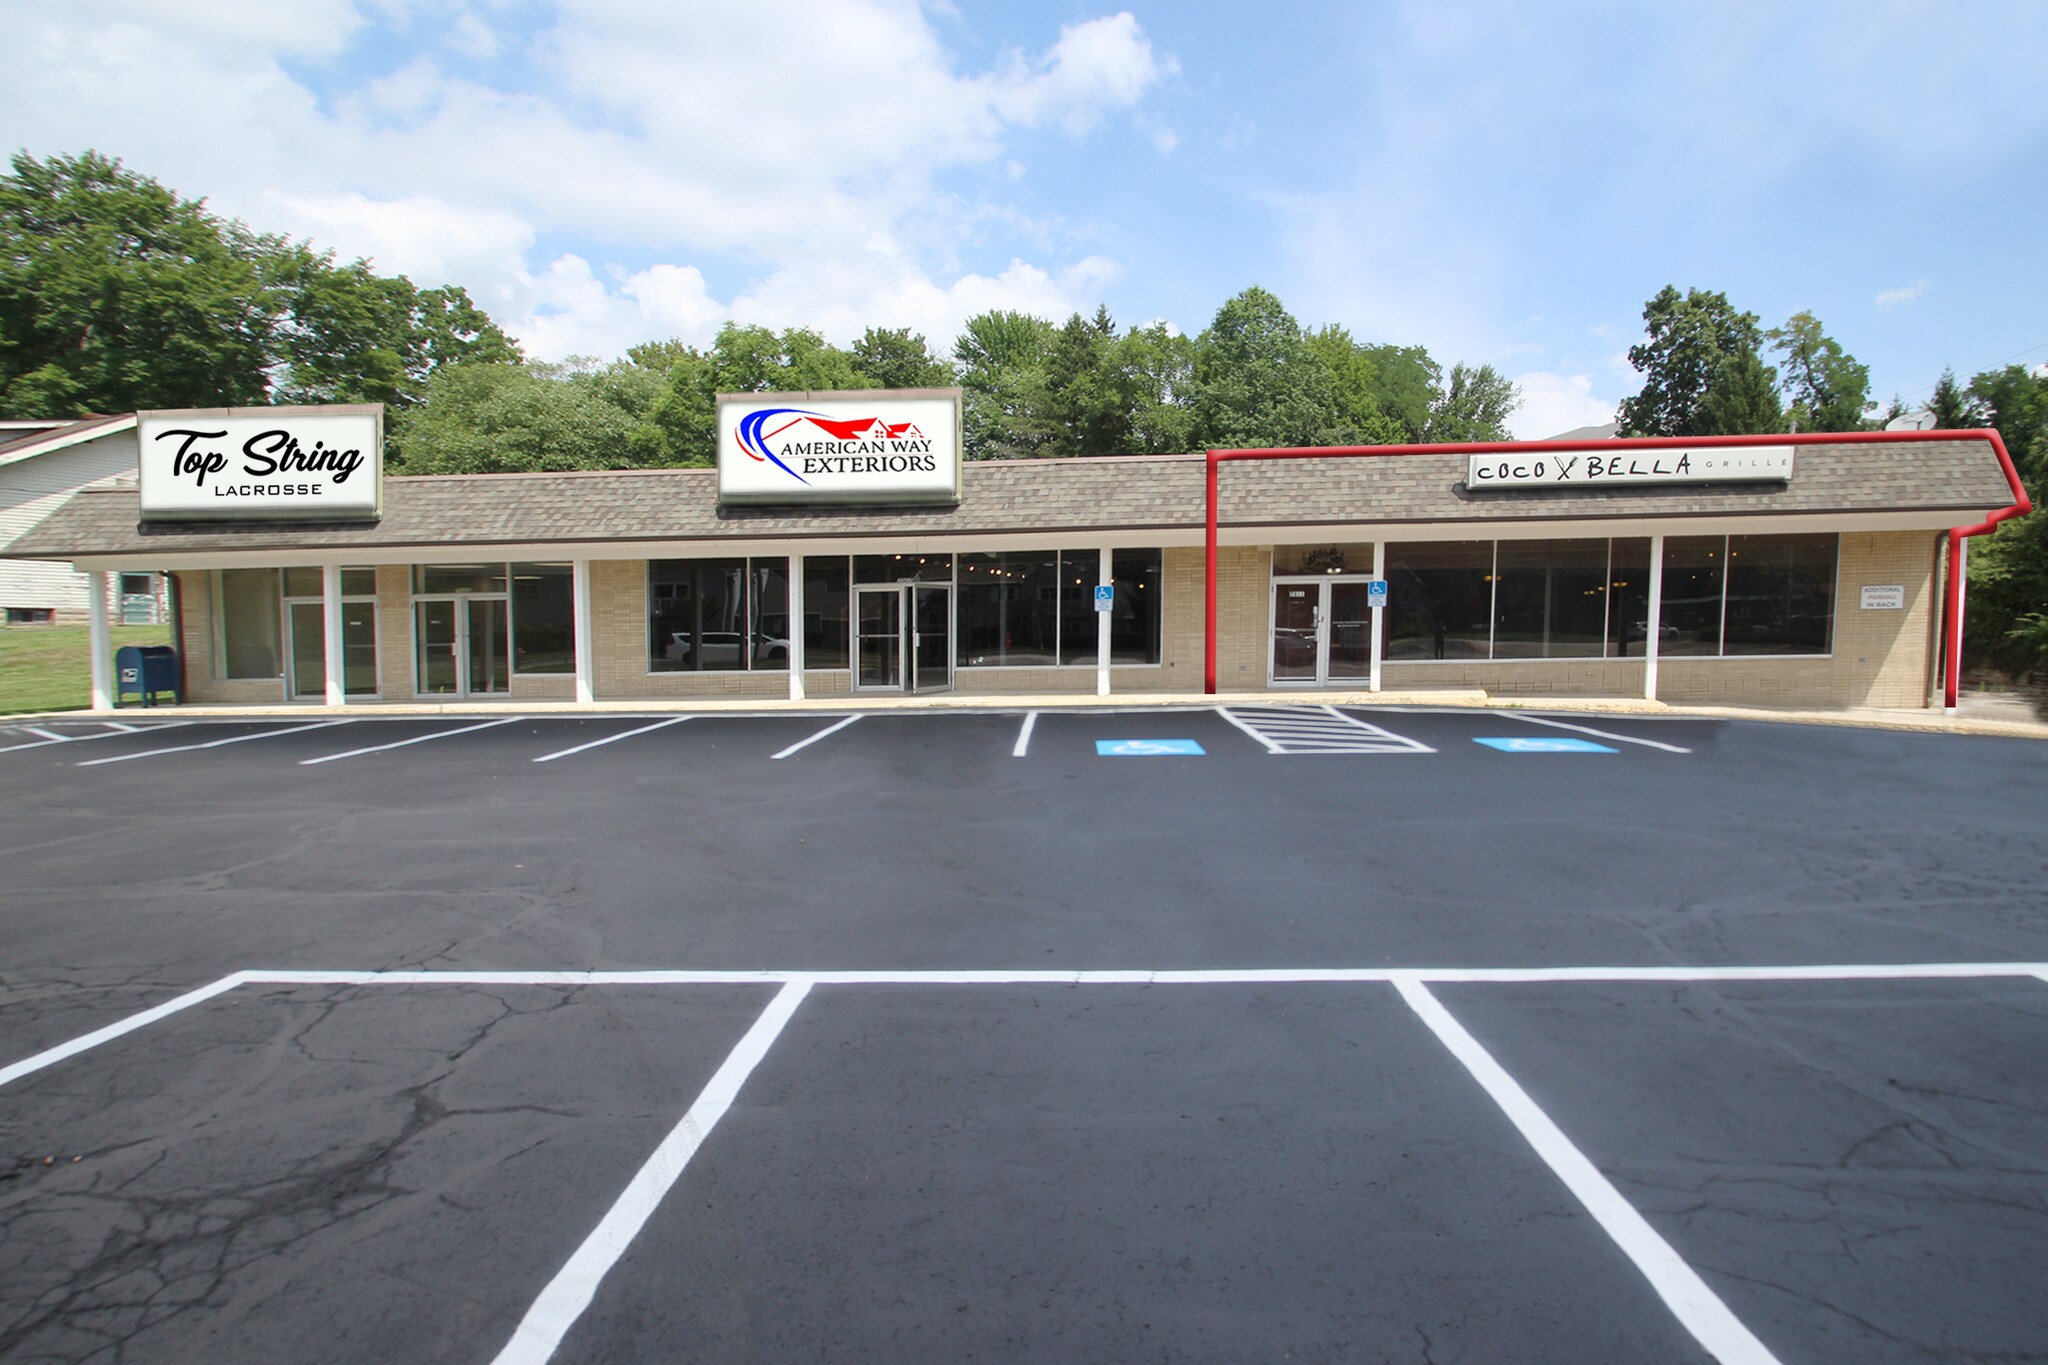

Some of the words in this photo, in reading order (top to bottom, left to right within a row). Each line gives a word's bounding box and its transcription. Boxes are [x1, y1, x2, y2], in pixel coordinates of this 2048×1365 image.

[781, 440, 885, 456] AMERICAN
[891, 439, 932, 453] WAY
[155, 429, 228, 487] Top
[242, 430, 365, 484] String
[803, 455, 936, 474] EXTERIORS
[1586, 453, 1691, 479] BELLA
[1706, 458, 1787, 469] GRILLE
[215, 484, 322, 497] LACROSSE
